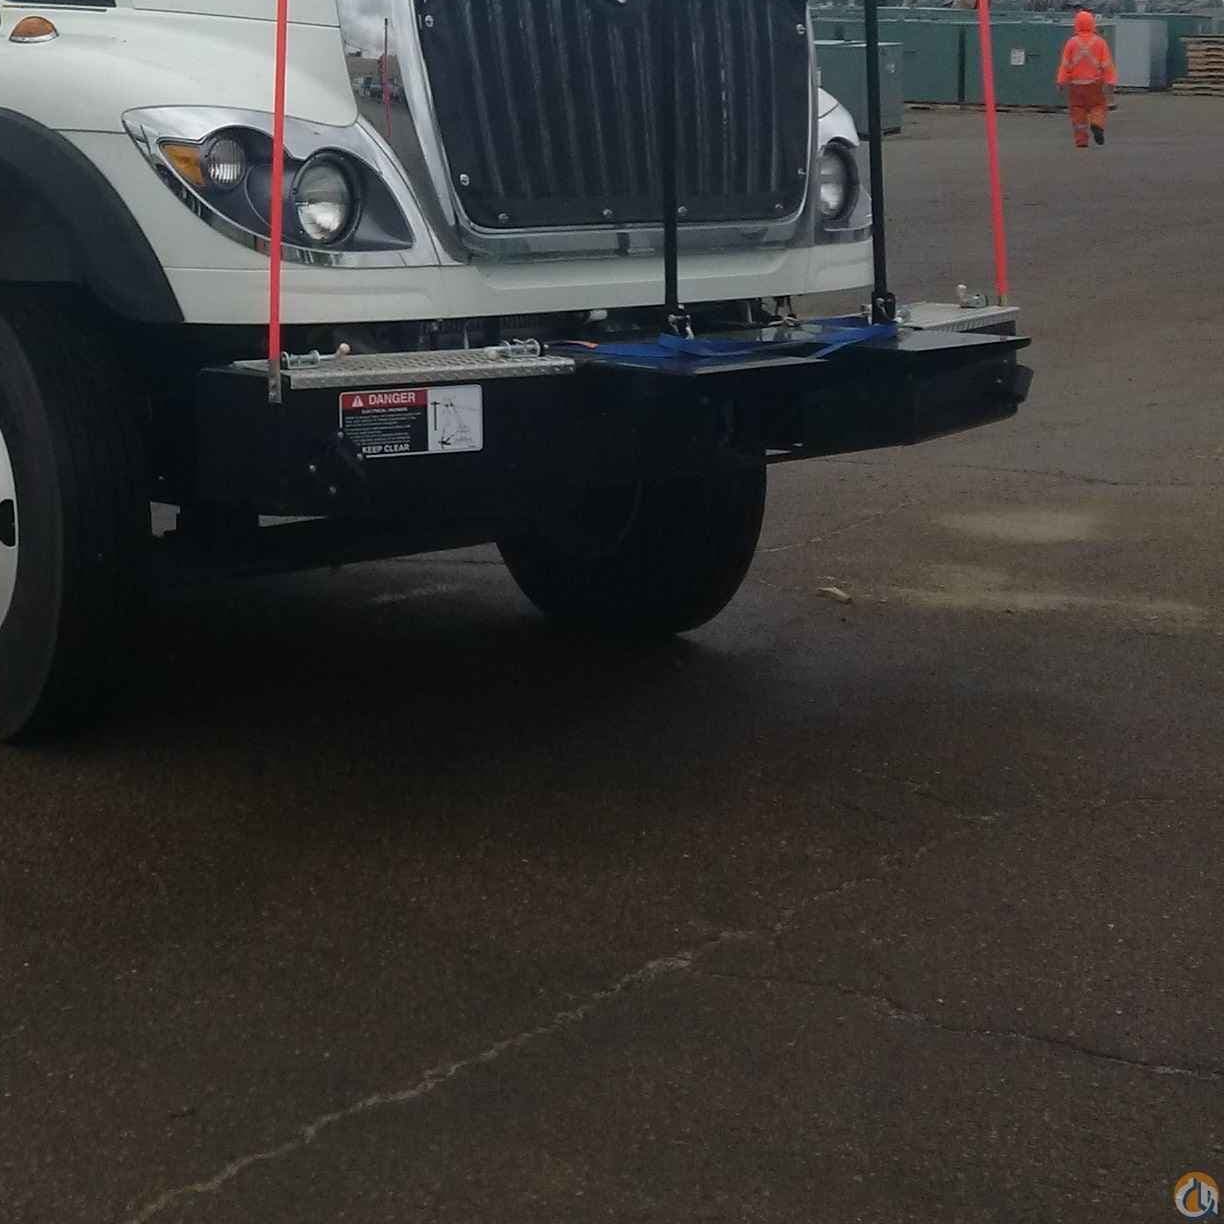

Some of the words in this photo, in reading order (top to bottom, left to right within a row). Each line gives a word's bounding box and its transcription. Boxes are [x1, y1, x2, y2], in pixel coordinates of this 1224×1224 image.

[368, 392, 416, 405] DANGER
[362, 445, 383, 454] KEEP
[383, 443, 410, 453] CLEAR
